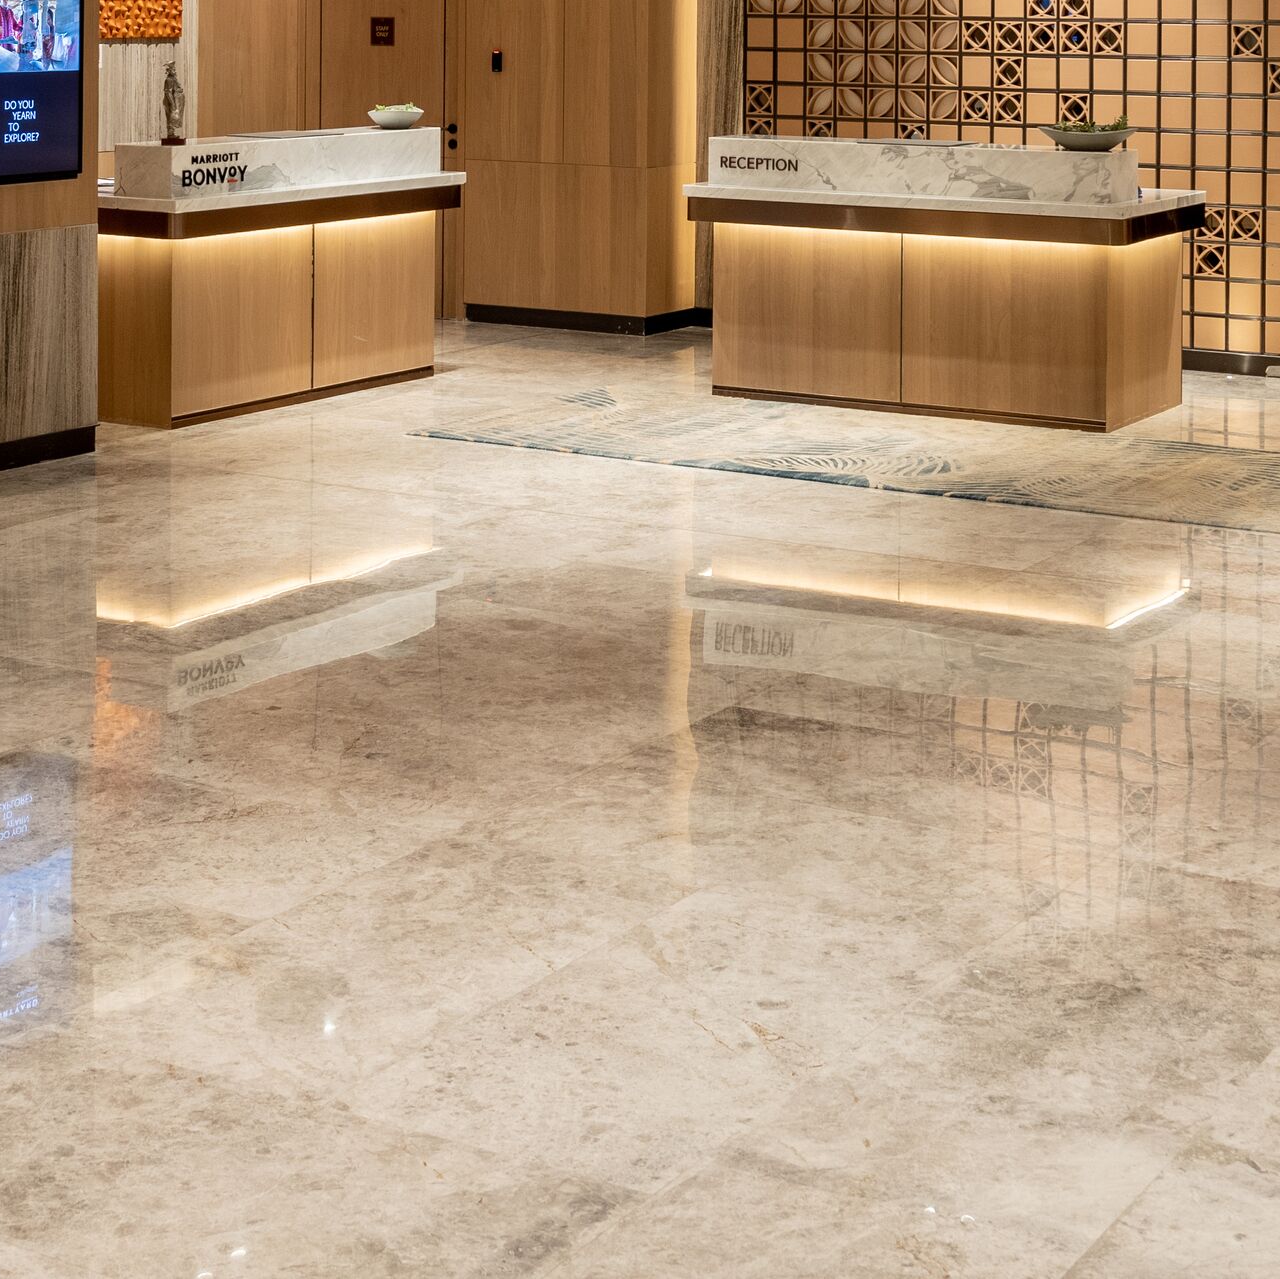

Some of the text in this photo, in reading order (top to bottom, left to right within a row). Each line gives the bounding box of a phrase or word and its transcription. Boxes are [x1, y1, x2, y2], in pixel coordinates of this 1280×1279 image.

[4, 99, 35, 110] DO YOU
[12, 110, 37, 121] YEARN
[7, 122, 20, 132] TO
[3, 132, 40, 144] EXPLORE?
[191, 152, 240, 165] MARRIOTT
[719, 156, 799, 172] RECEPTION
[181, 165, 248, 188] BONVOY
